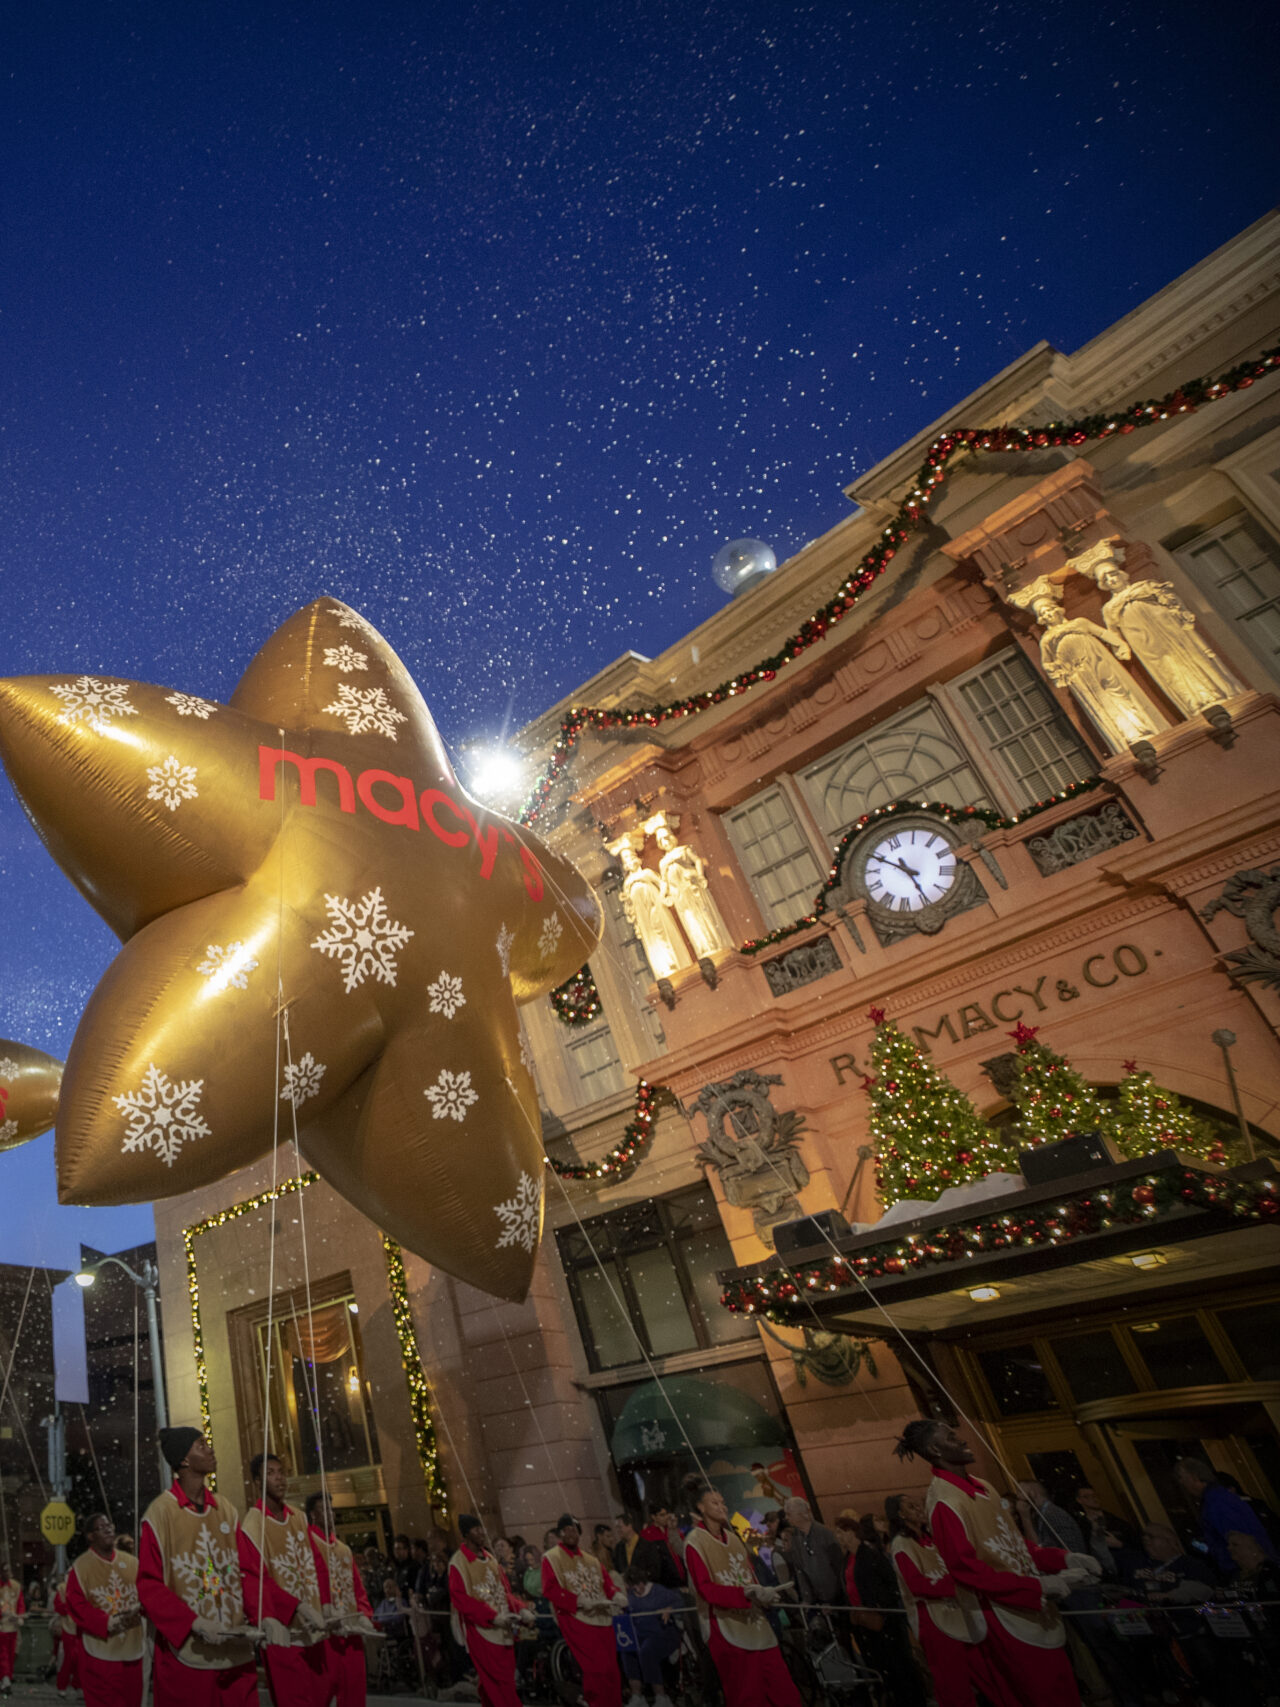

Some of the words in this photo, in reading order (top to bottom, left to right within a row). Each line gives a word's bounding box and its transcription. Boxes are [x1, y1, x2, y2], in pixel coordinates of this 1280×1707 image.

[911, 975, 1048, 1055] MACY
[1056, 979, 1081, 1002] &
[45, 1514, 73, 1531] STOP
